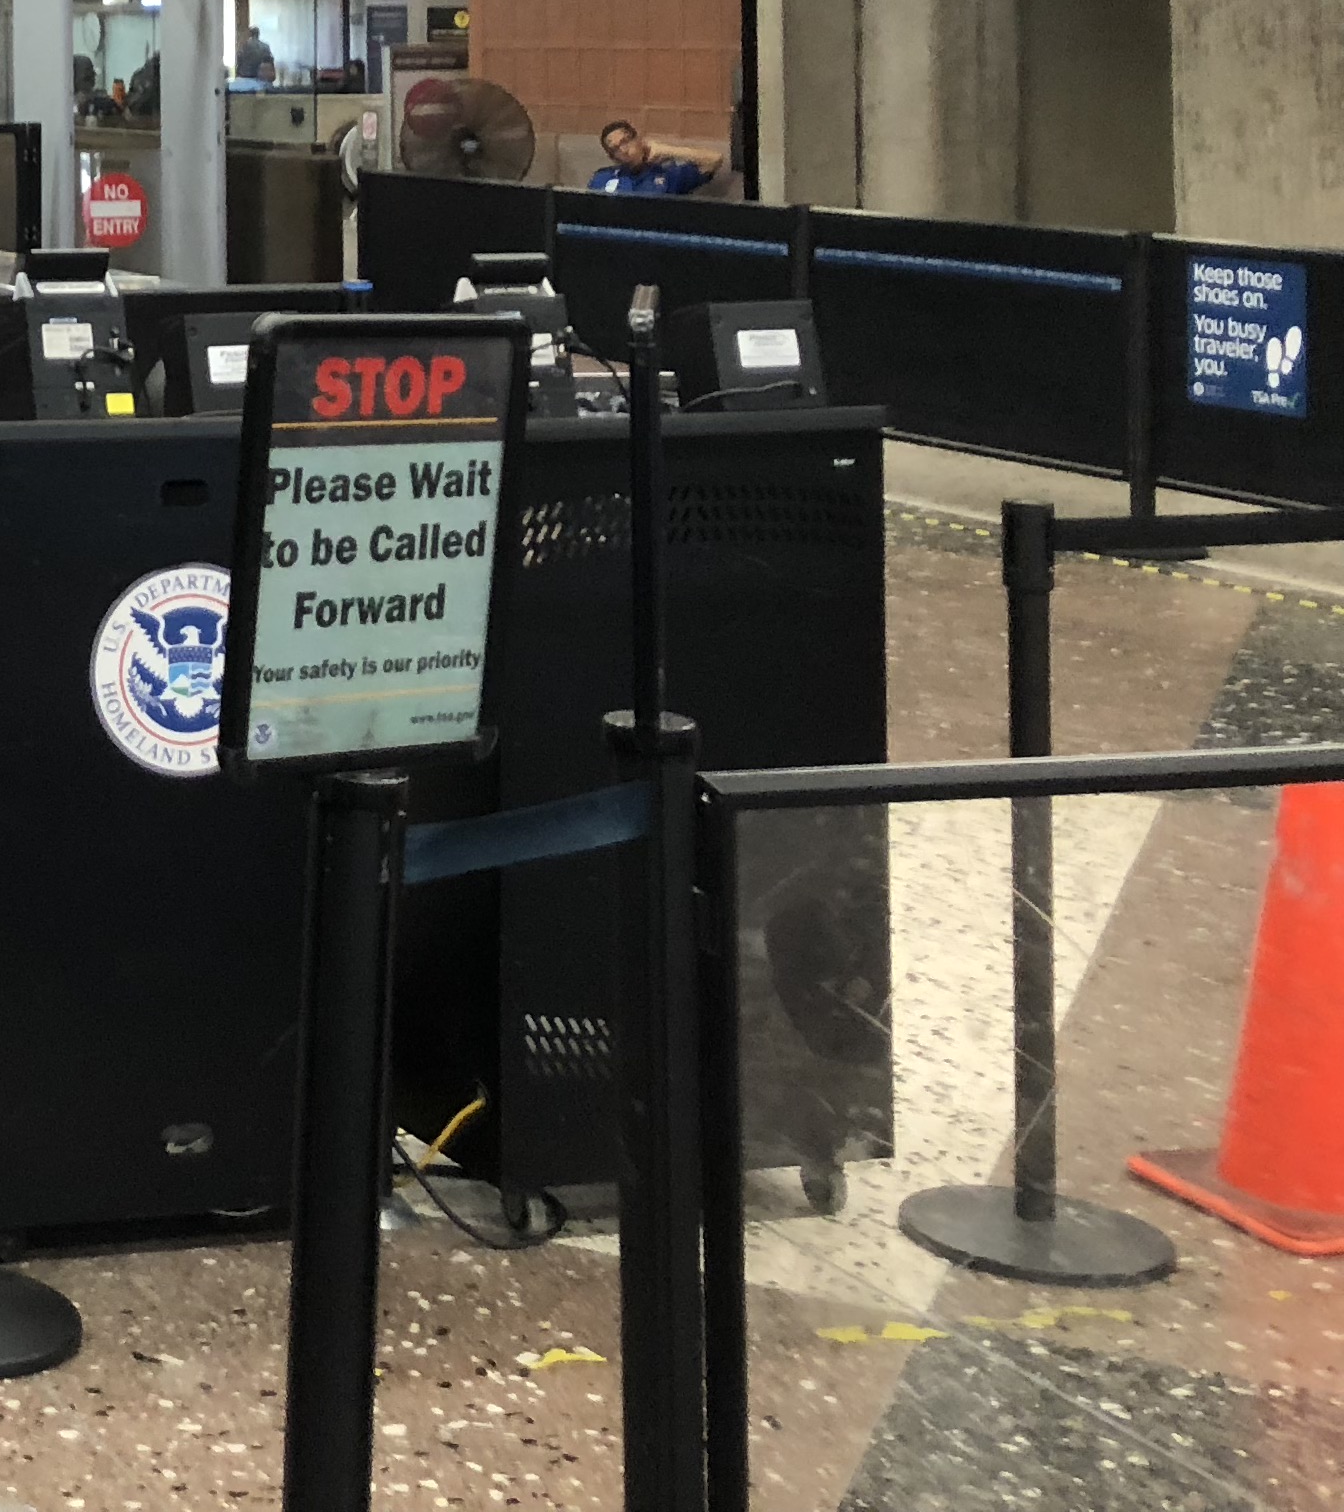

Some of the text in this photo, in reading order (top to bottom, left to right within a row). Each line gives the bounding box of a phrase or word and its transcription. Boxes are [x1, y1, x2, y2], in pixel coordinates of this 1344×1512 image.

[104, 183, 129, 199] NO
[93, 218, 140, 236] ENTRY
[1192, 262, 1283, 291] Keep those
[1193, 285, 1268, 311] shoes on.
[1193, 313, 1267, 343] You busy
[1194, 336, 1259, 362] traveler,
[1194, 358, 1228, 377] you.
[312, 356, 466, 417] STOP
[268, 460, 492, 504] Please Wait
[263, 520, 486, 568] to be Called
[293, 584, 446, 629] Forward
[253, 649, 480, 683] Your safety is our priority
[101, 680, 192, 766] HOMELAND
